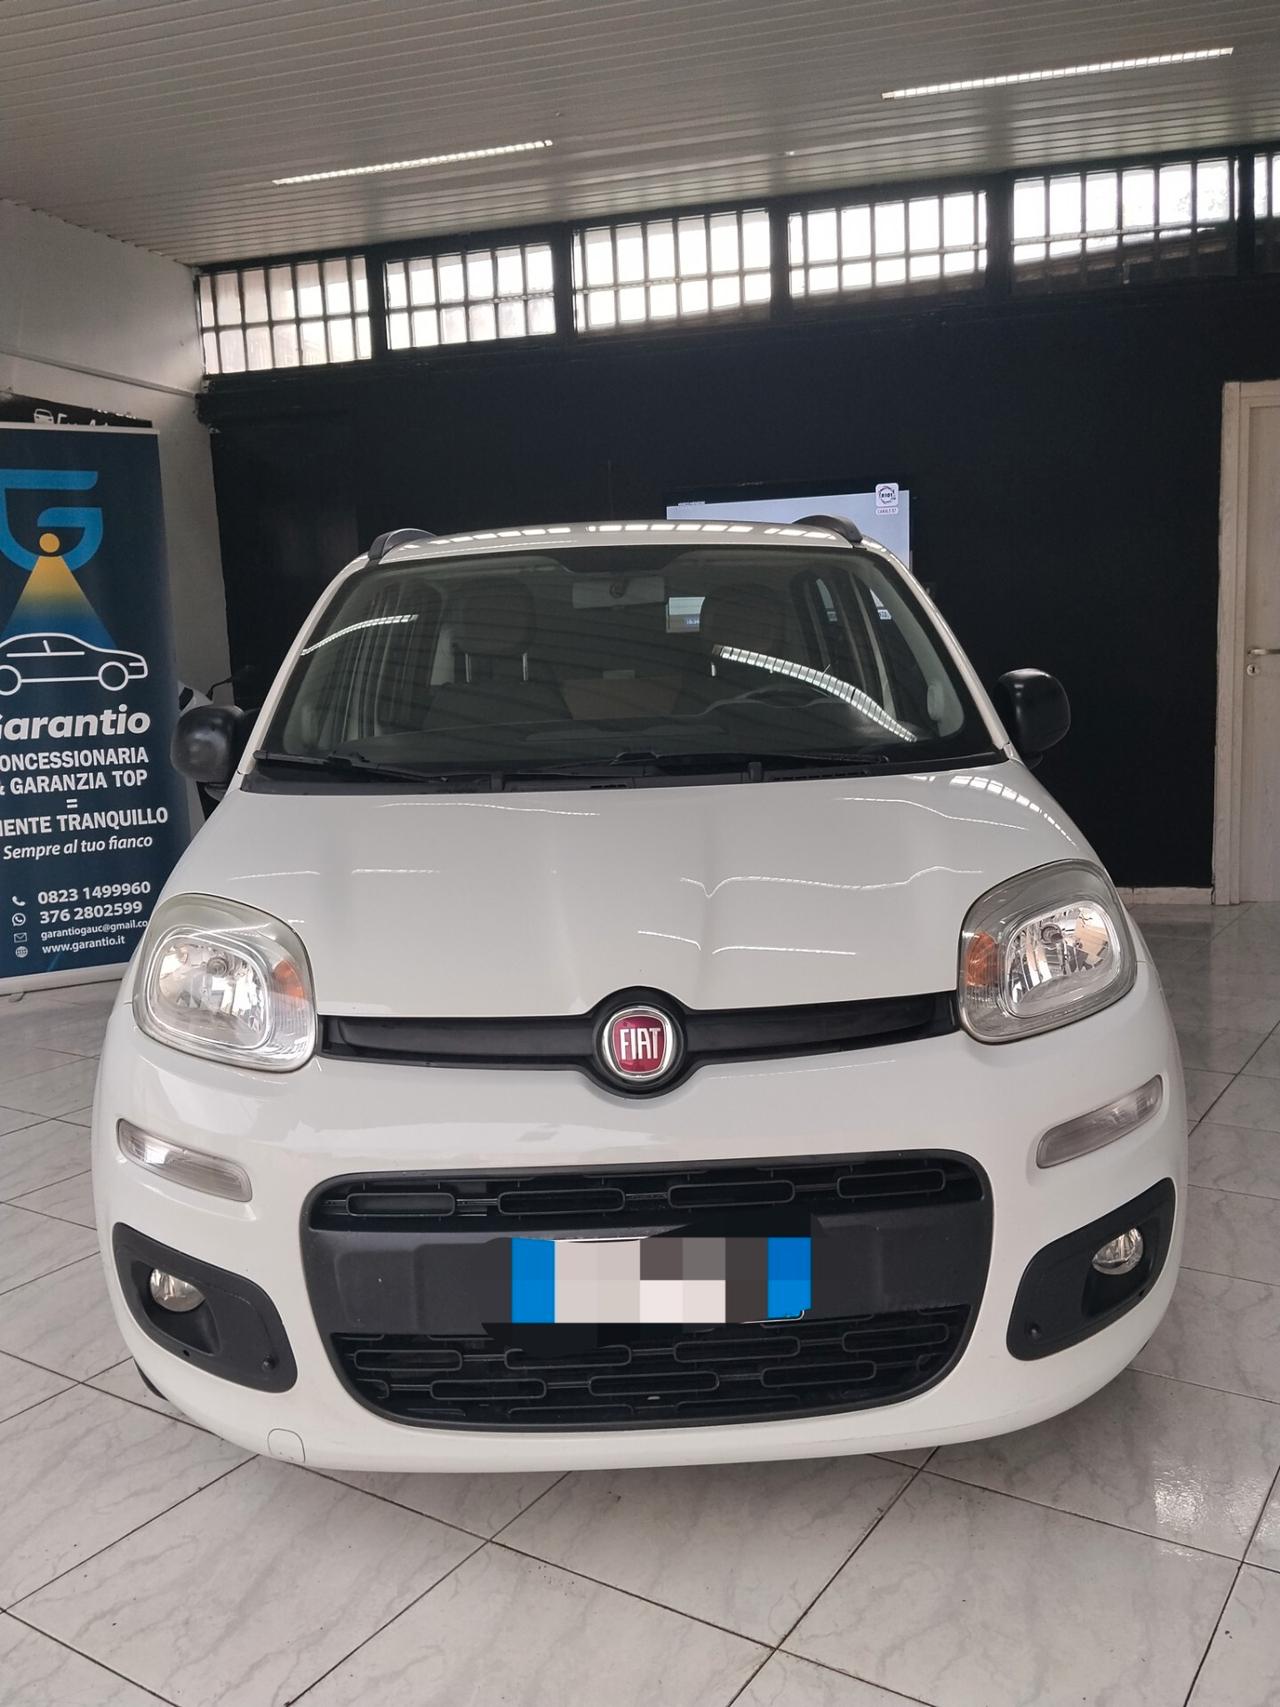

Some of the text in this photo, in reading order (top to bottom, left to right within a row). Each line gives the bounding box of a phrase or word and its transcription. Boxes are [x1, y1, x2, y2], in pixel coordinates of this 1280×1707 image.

[0, 704, 150, 740] arantio
[0, 747, 149, 772] ONCESSIONARIA
[10, 772, 107, 795] GARANZIA
[112, 769, 148, 787] TOP
[0, 807, 168, 837] IENTE TRANQUILLO
[3, 835, 153, 860] Sempre al tuo fianco
[37, 881, 151, 905] 0823 1499960
[39, 901, 143, 924] 376 2802599
[40, 919, 148, 941] garantiogauc@gmail.co
[42, 935, 125, 954] www.garantio.it
[619, 1027, 661, 1060] FIAT
